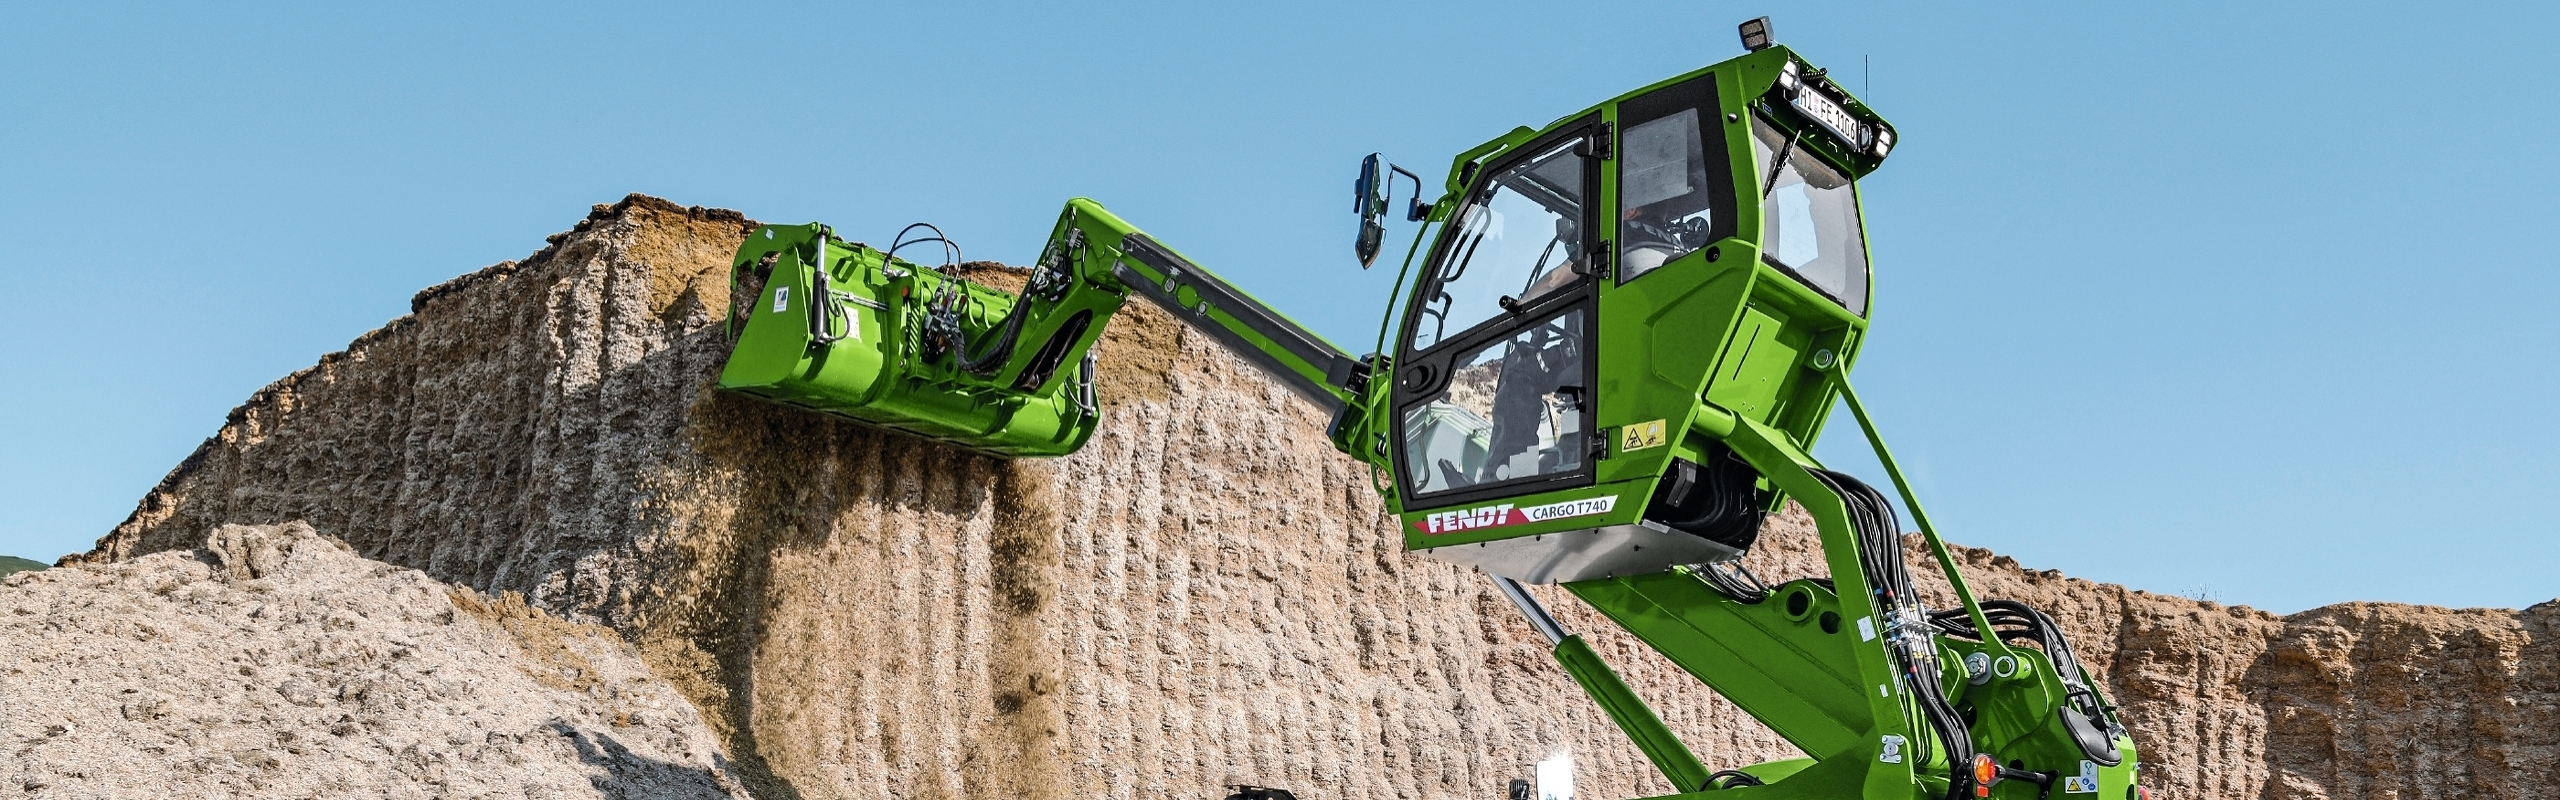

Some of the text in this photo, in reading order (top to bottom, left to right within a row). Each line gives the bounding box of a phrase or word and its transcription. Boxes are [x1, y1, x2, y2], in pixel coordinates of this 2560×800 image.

[1821, 100, 1832, 124] FE
[1427, 503, 1514, 533] FENDT
[1533, 500, 1607, 519] CARGO T740
